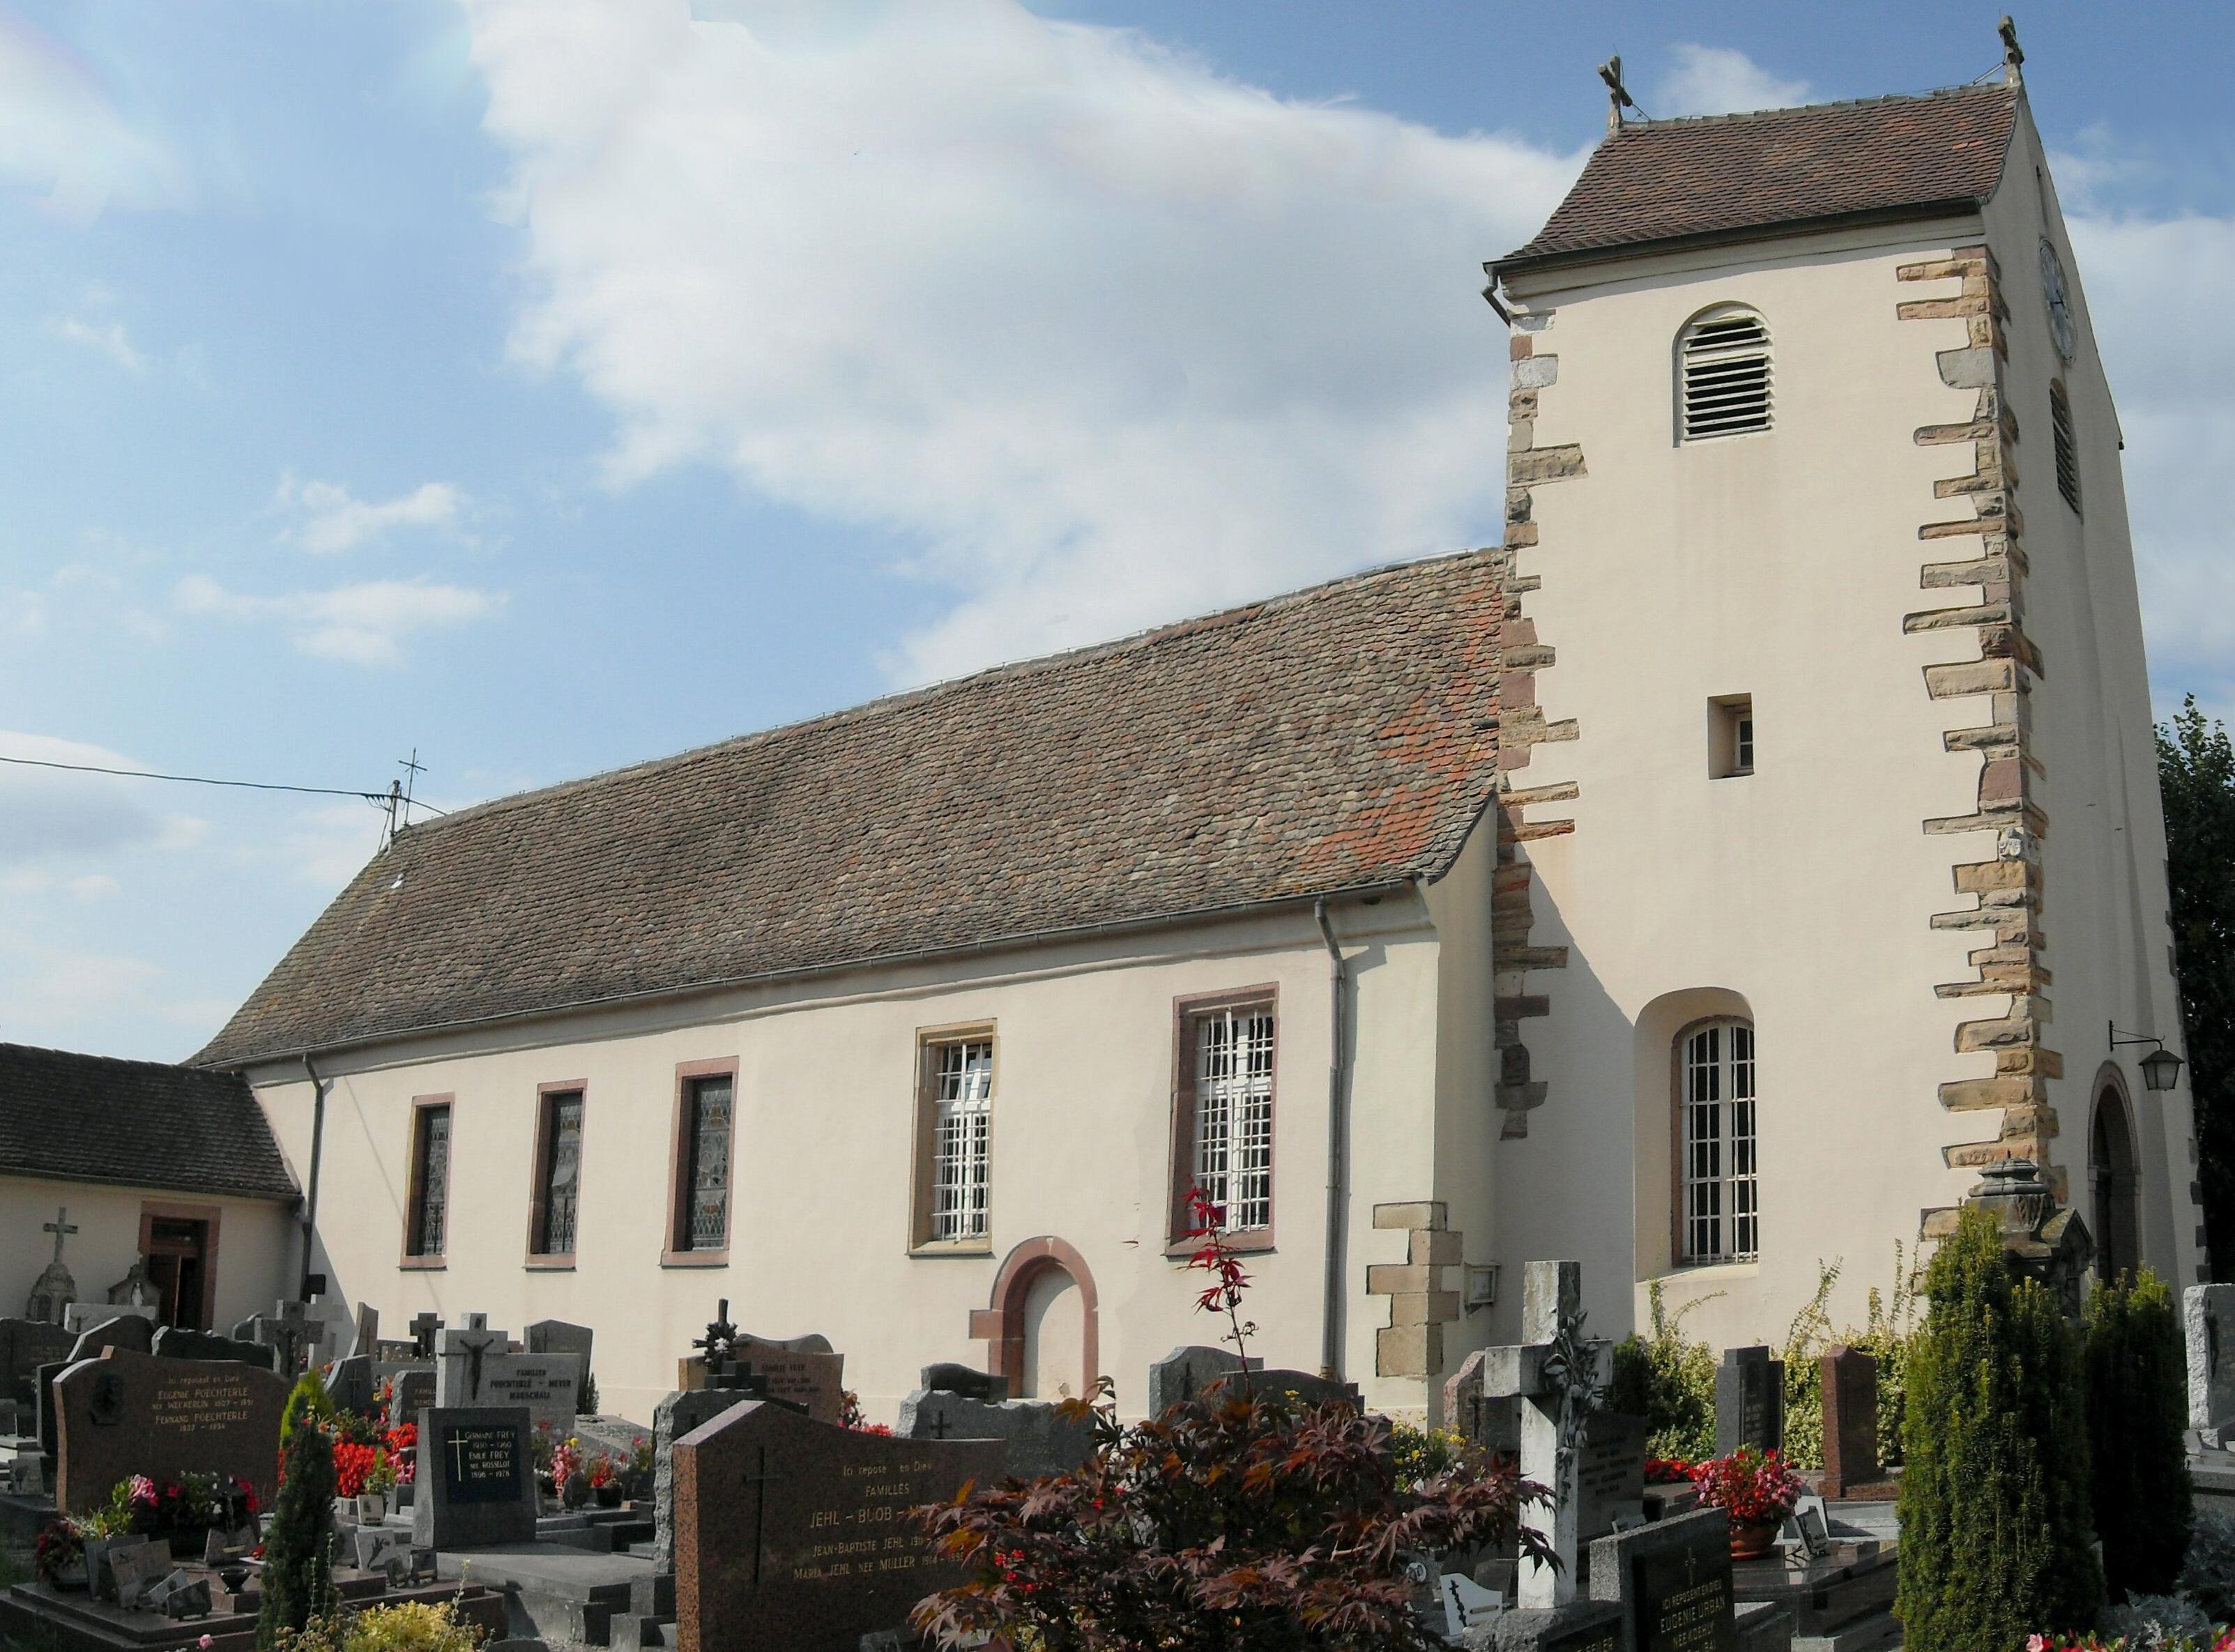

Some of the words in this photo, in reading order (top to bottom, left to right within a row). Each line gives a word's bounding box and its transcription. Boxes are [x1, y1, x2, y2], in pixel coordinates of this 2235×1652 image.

[194, 1387, 248, 1398] FOECHTERLE
[194, 1411, 248, 1422] FOECHTERLE
[496, 1430, 515, 1439] FREY
[490, 1451, 510, 1459] FREY
[844, 1465, 853, 1476] Ici
[858, 1465, 887, 1478] repose
[899, 1464, 909, 1473] en
[914, 1461, 933, 1472] Dieu
[865, 1483, 910, 1497] FAMILLES
[810, 1511, 840, 1529] JEHL
[858, 1507, 892, 1523] BUOB
[813, 1540, 877, 1557] JEAN-BAPTISTE
[883, 1536, 904, 1550] JEHL
[793, 1568, 822, 1580] MARIA
[829, 1563, 851, 1577] JEHL
[858, 1562, 874, 1573] NEE
[1661, 1607, 1697, 1633] EUGENIE
[1698, 1593, 1725, 1618] URBAN
